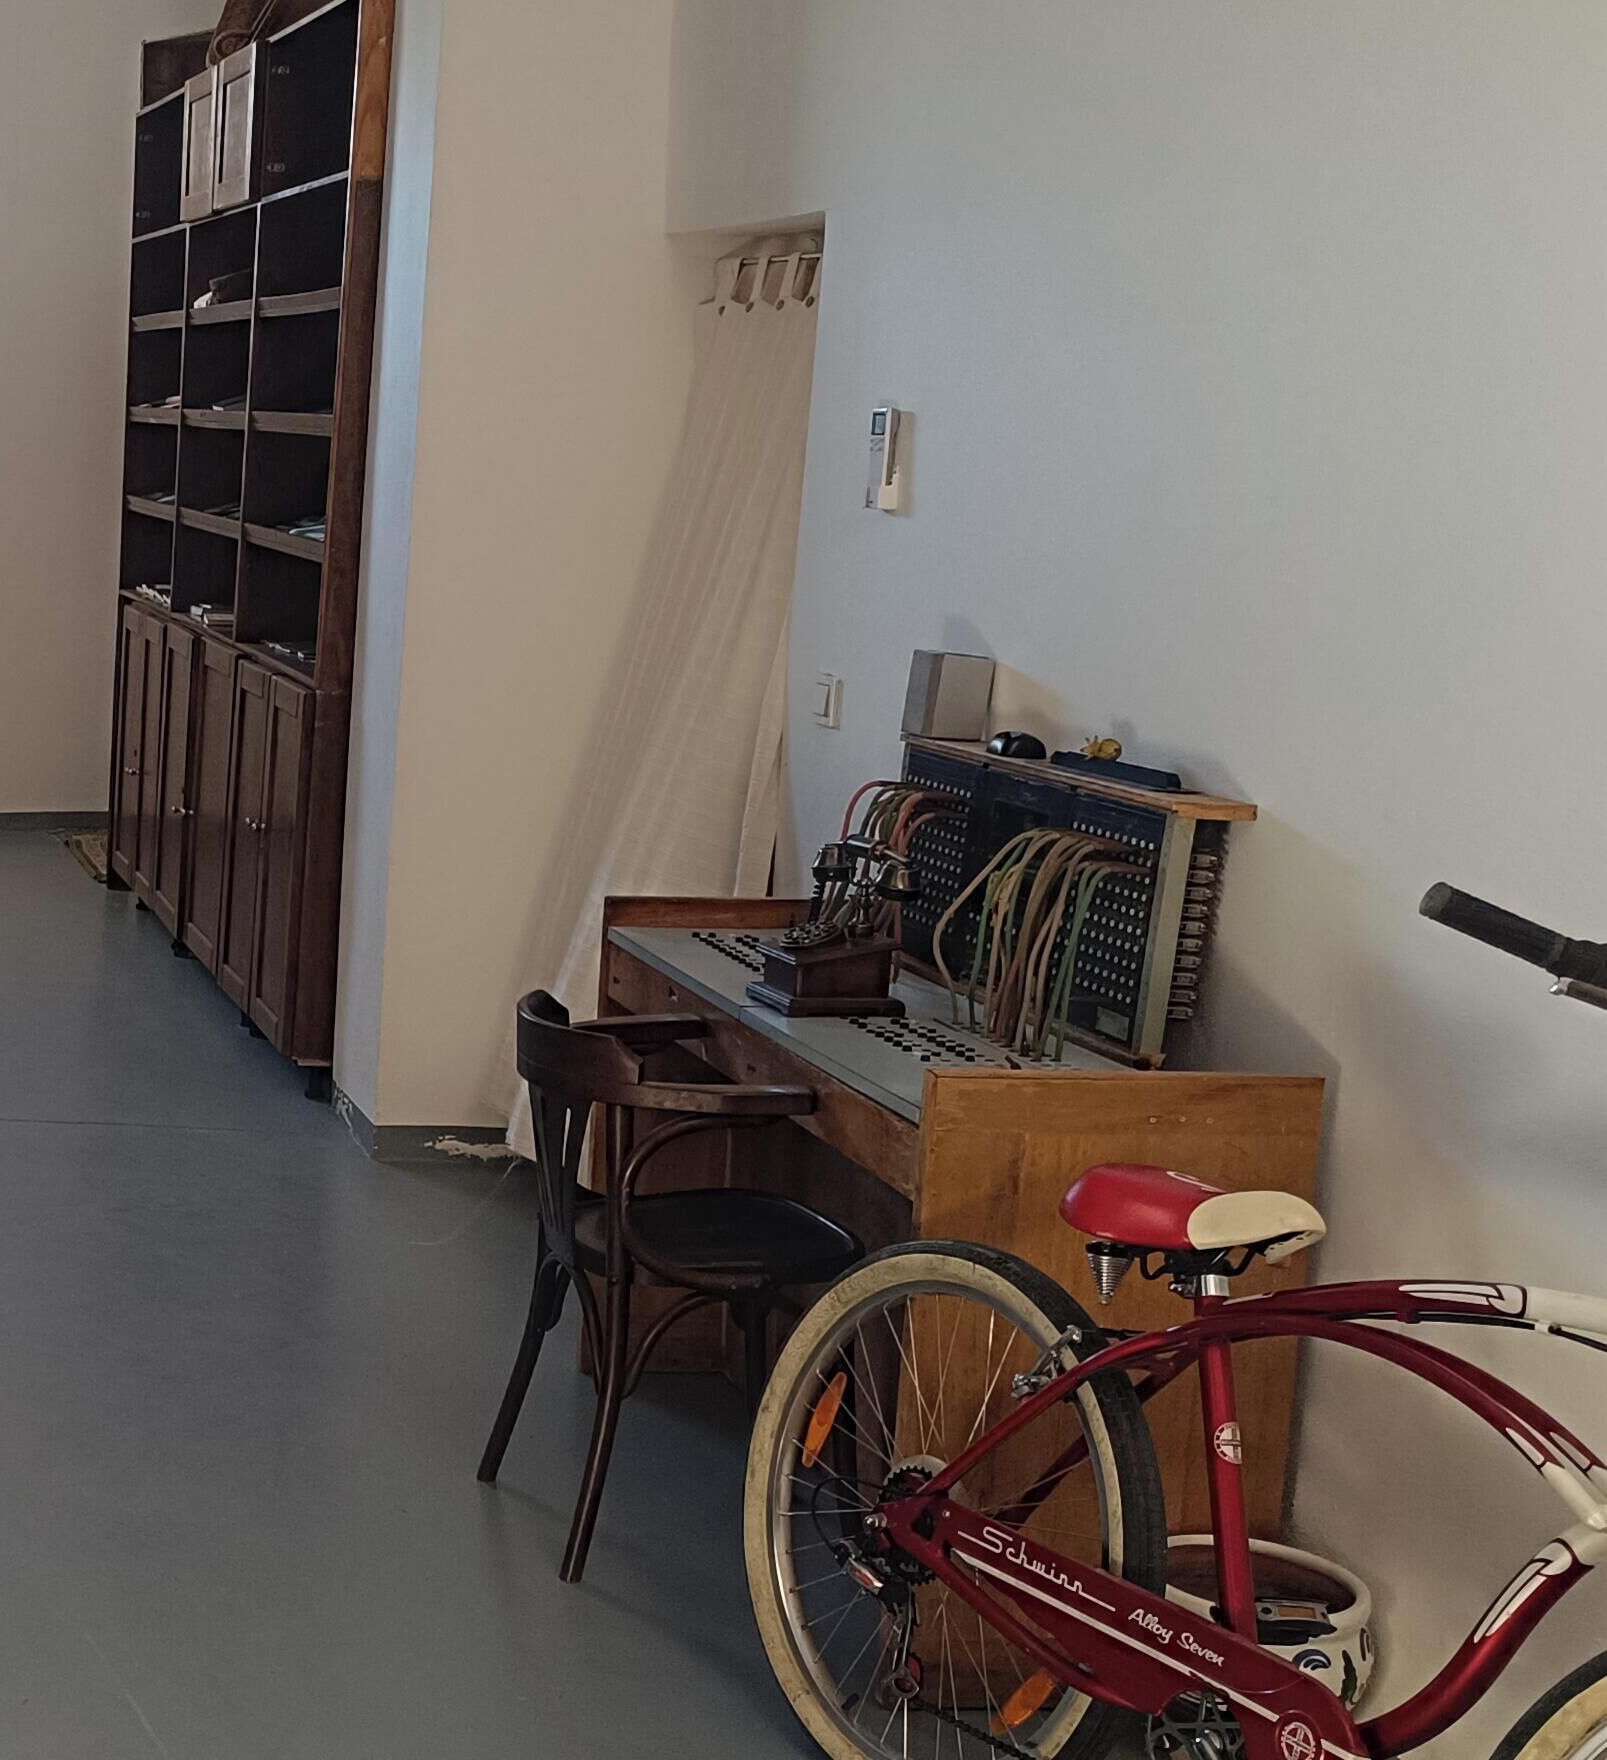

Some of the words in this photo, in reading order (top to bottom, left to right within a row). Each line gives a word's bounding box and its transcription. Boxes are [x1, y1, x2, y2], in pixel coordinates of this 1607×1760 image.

[958, 1526, 1116, 1611] Schwinn
[1128, 1608, 1173, 1644] Alloy
[1179, 1632, 1224, 1667] Seven
